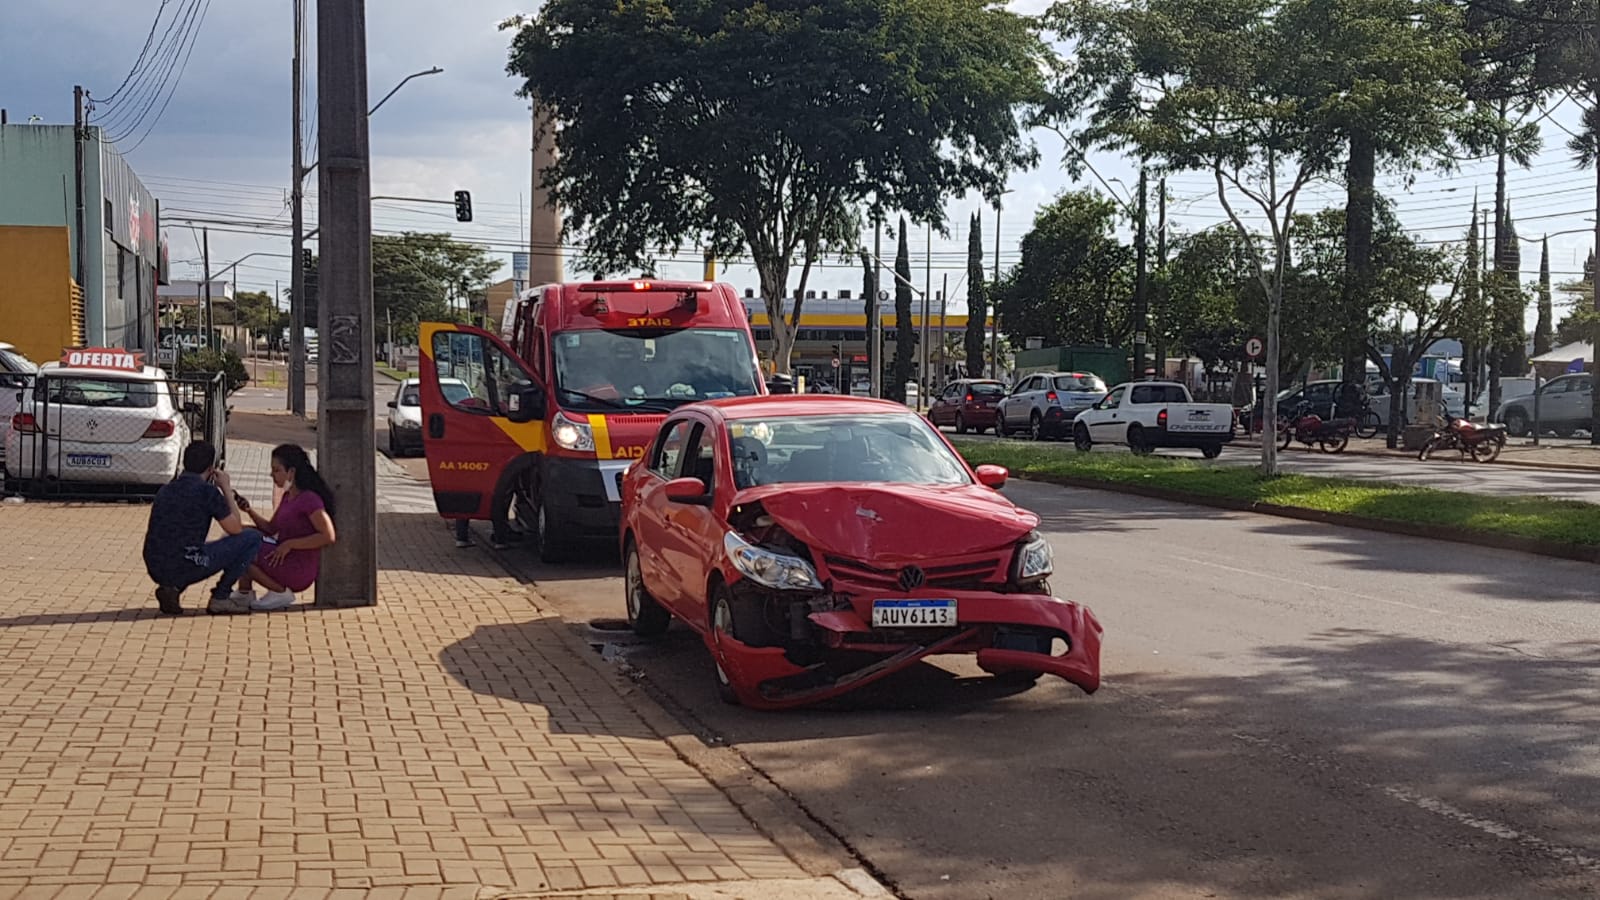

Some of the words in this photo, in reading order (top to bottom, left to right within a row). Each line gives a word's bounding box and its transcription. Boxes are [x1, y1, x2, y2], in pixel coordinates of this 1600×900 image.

[69, 352, 135, 369] OFERTA
[439, 461, 455, 469] AA
[457, 461, 489, 471] 14067
[880, 608, 948, 624] AUY6I13
